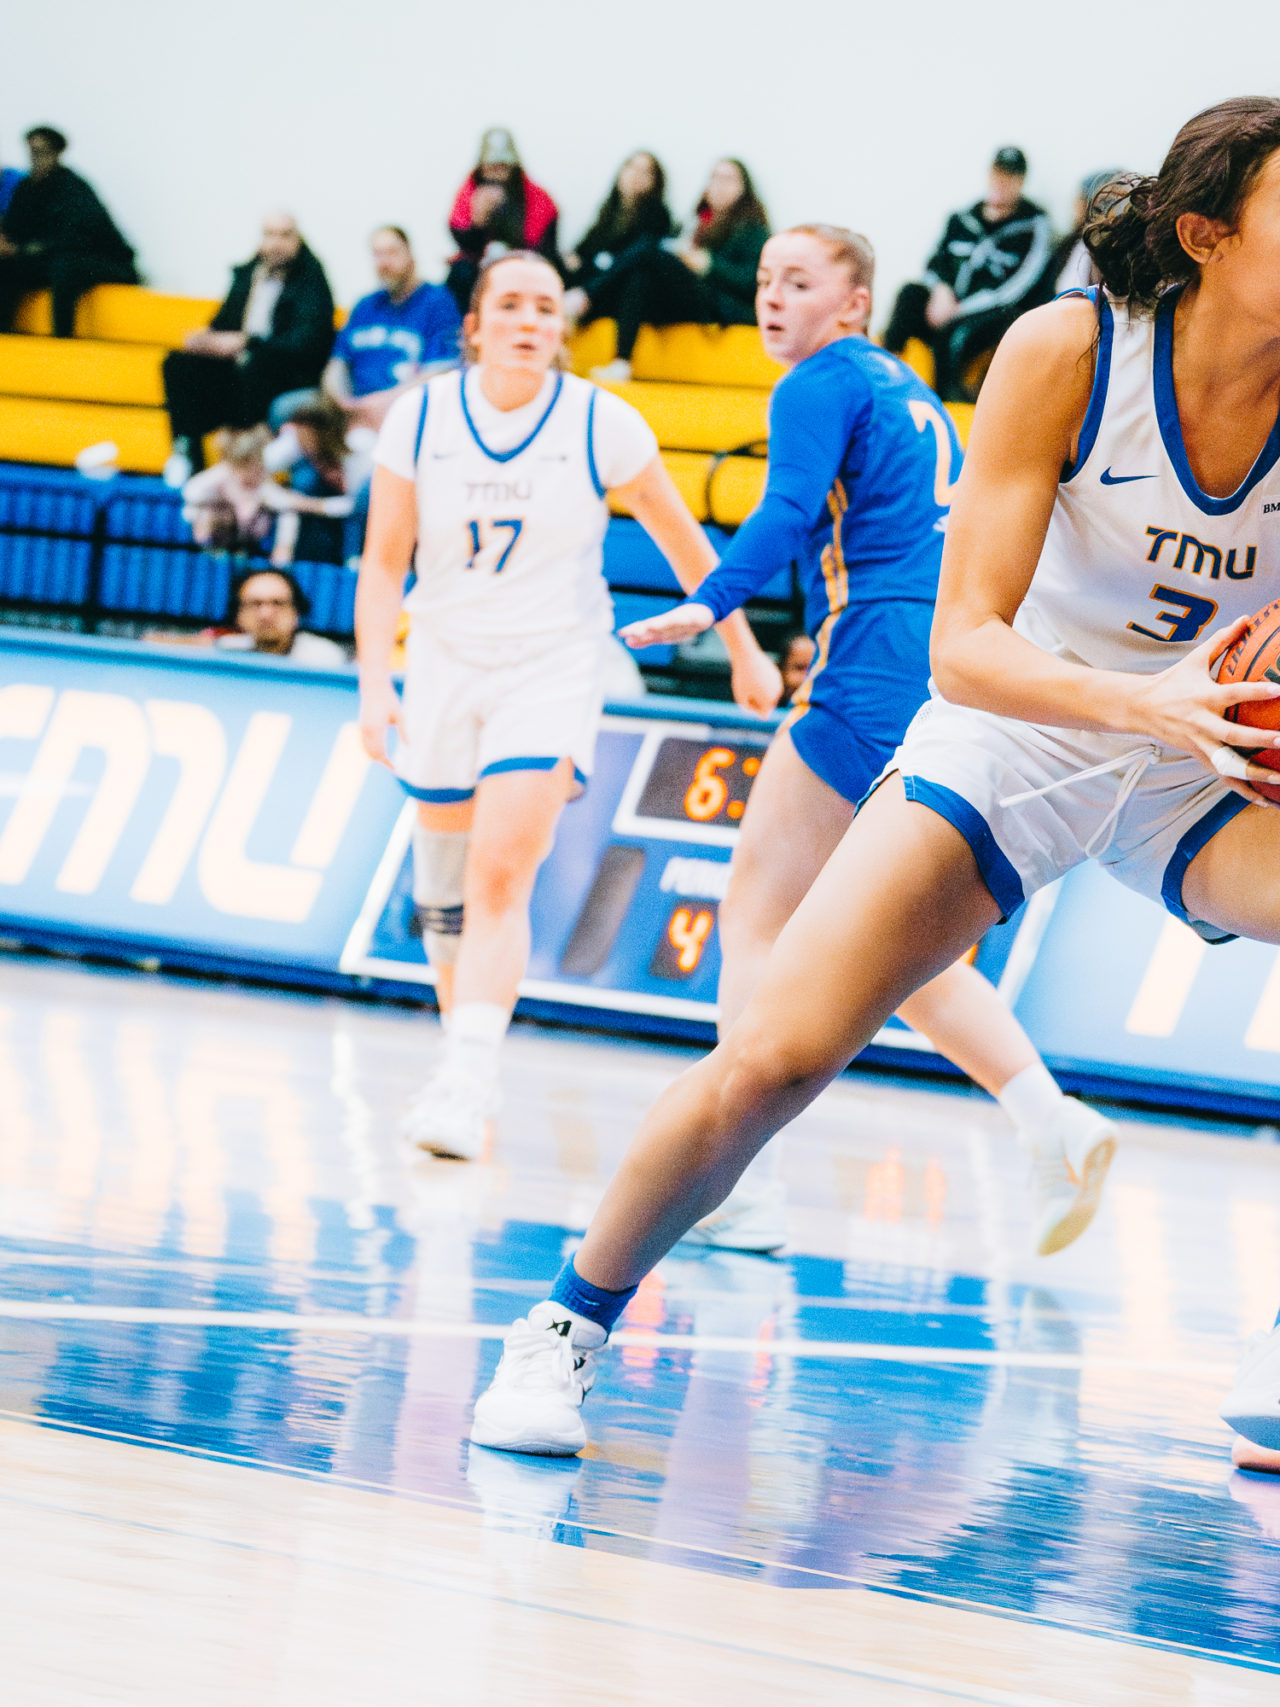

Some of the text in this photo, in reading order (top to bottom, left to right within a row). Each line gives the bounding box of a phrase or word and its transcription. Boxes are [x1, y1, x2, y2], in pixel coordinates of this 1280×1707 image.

[464, 516, 526, 574] 17
[1145, 525, 1257, 580] TMU
[1126, 583, 1219, 642] 3
[668, 907, 713, 972] 4
